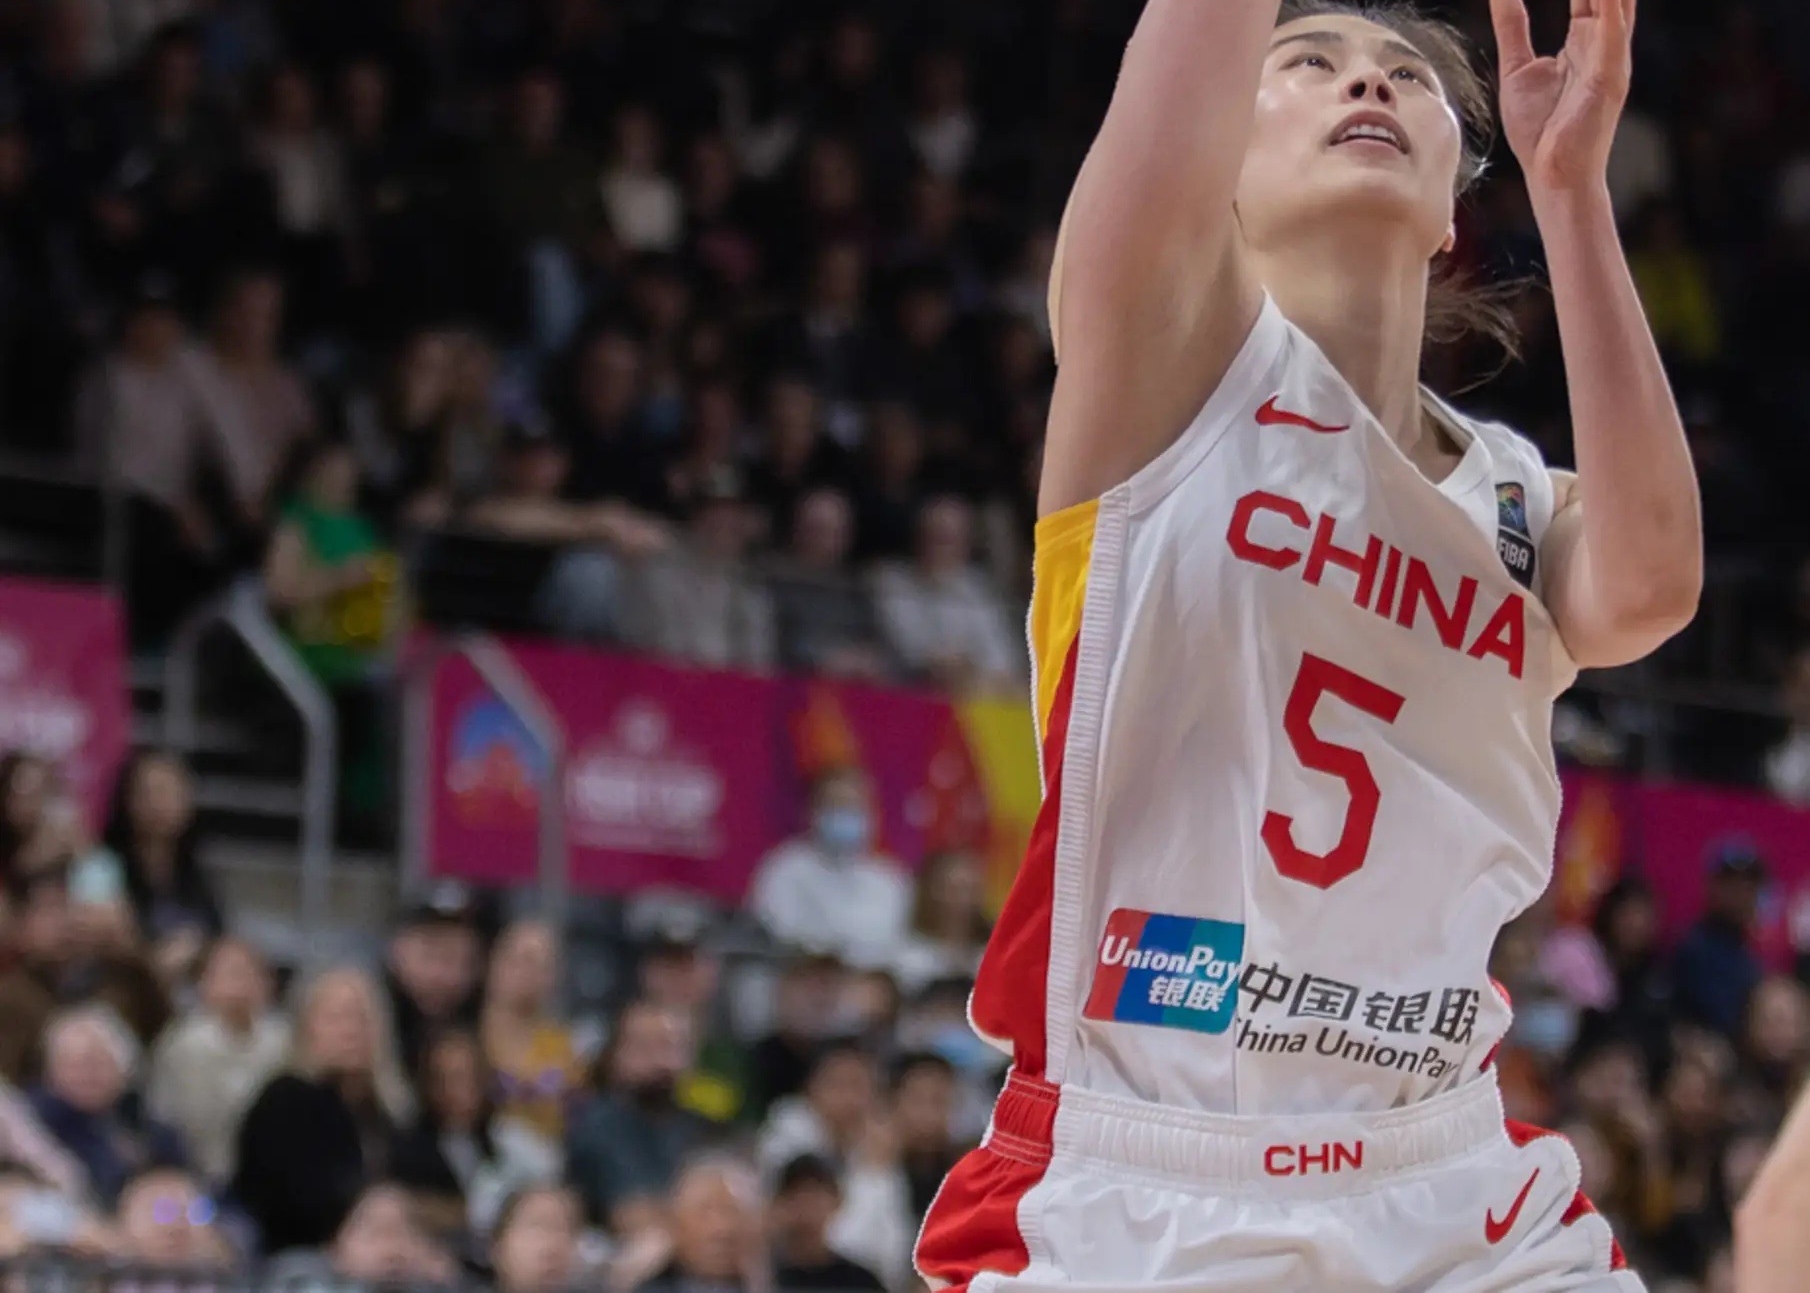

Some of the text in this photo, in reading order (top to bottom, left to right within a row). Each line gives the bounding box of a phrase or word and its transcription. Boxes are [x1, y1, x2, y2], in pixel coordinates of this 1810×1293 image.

[1498, 536, 1529, 572] FIBA
[1226, 490, 1525, 679] CHINA
[1260, 651, 1406, 890] 5
[1101, 934, 1240, 991] UnionPay
[1148, 975, 1226, 1013] 银联
[1239, 962, 1480, 1045] 中国银联
[1236, 1017, 1307, 1054] hina
[1264, 1140, 1363, 1176] CHN
